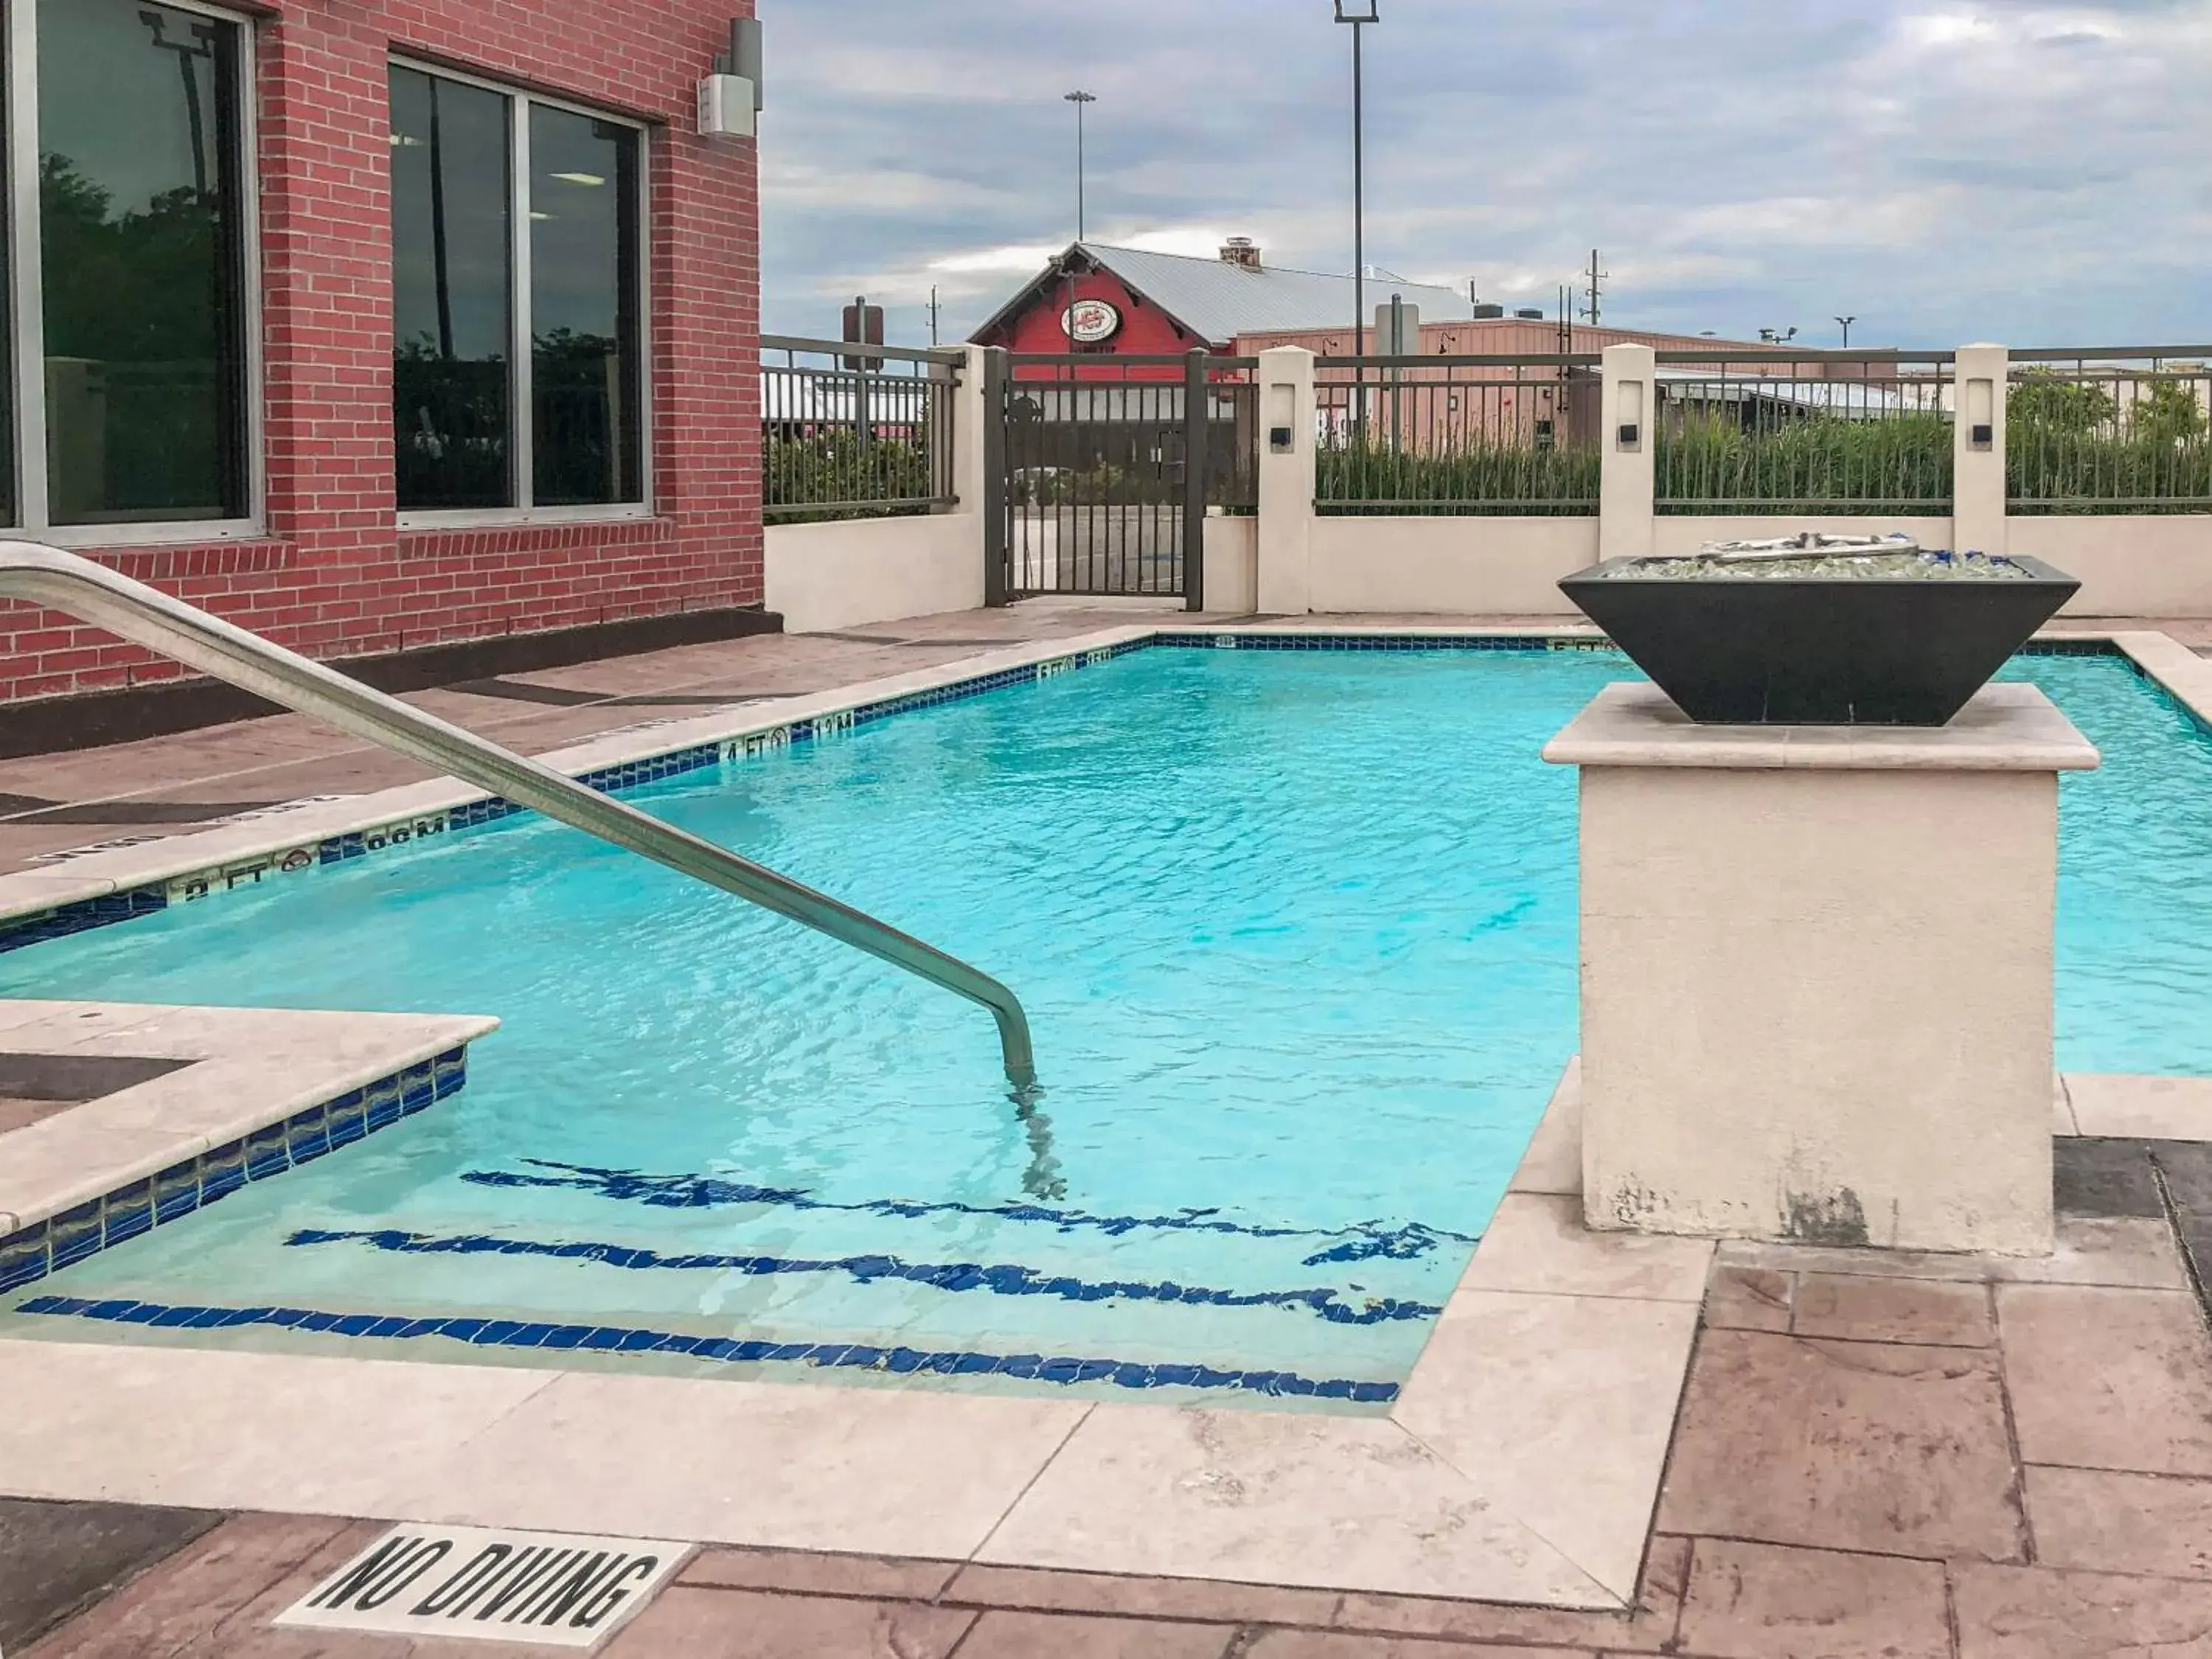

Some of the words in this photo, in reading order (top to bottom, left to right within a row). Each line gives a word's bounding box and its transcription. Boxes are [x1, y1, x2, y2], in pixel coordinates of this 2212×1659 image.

[728, 742, 737, 759] 4
[747, 733, 766, 754] FT
[226, 862, 268, 889] FT
[306, 1536, 453, 1611] NO
[407, 1543, 658, 1628] DIVING
